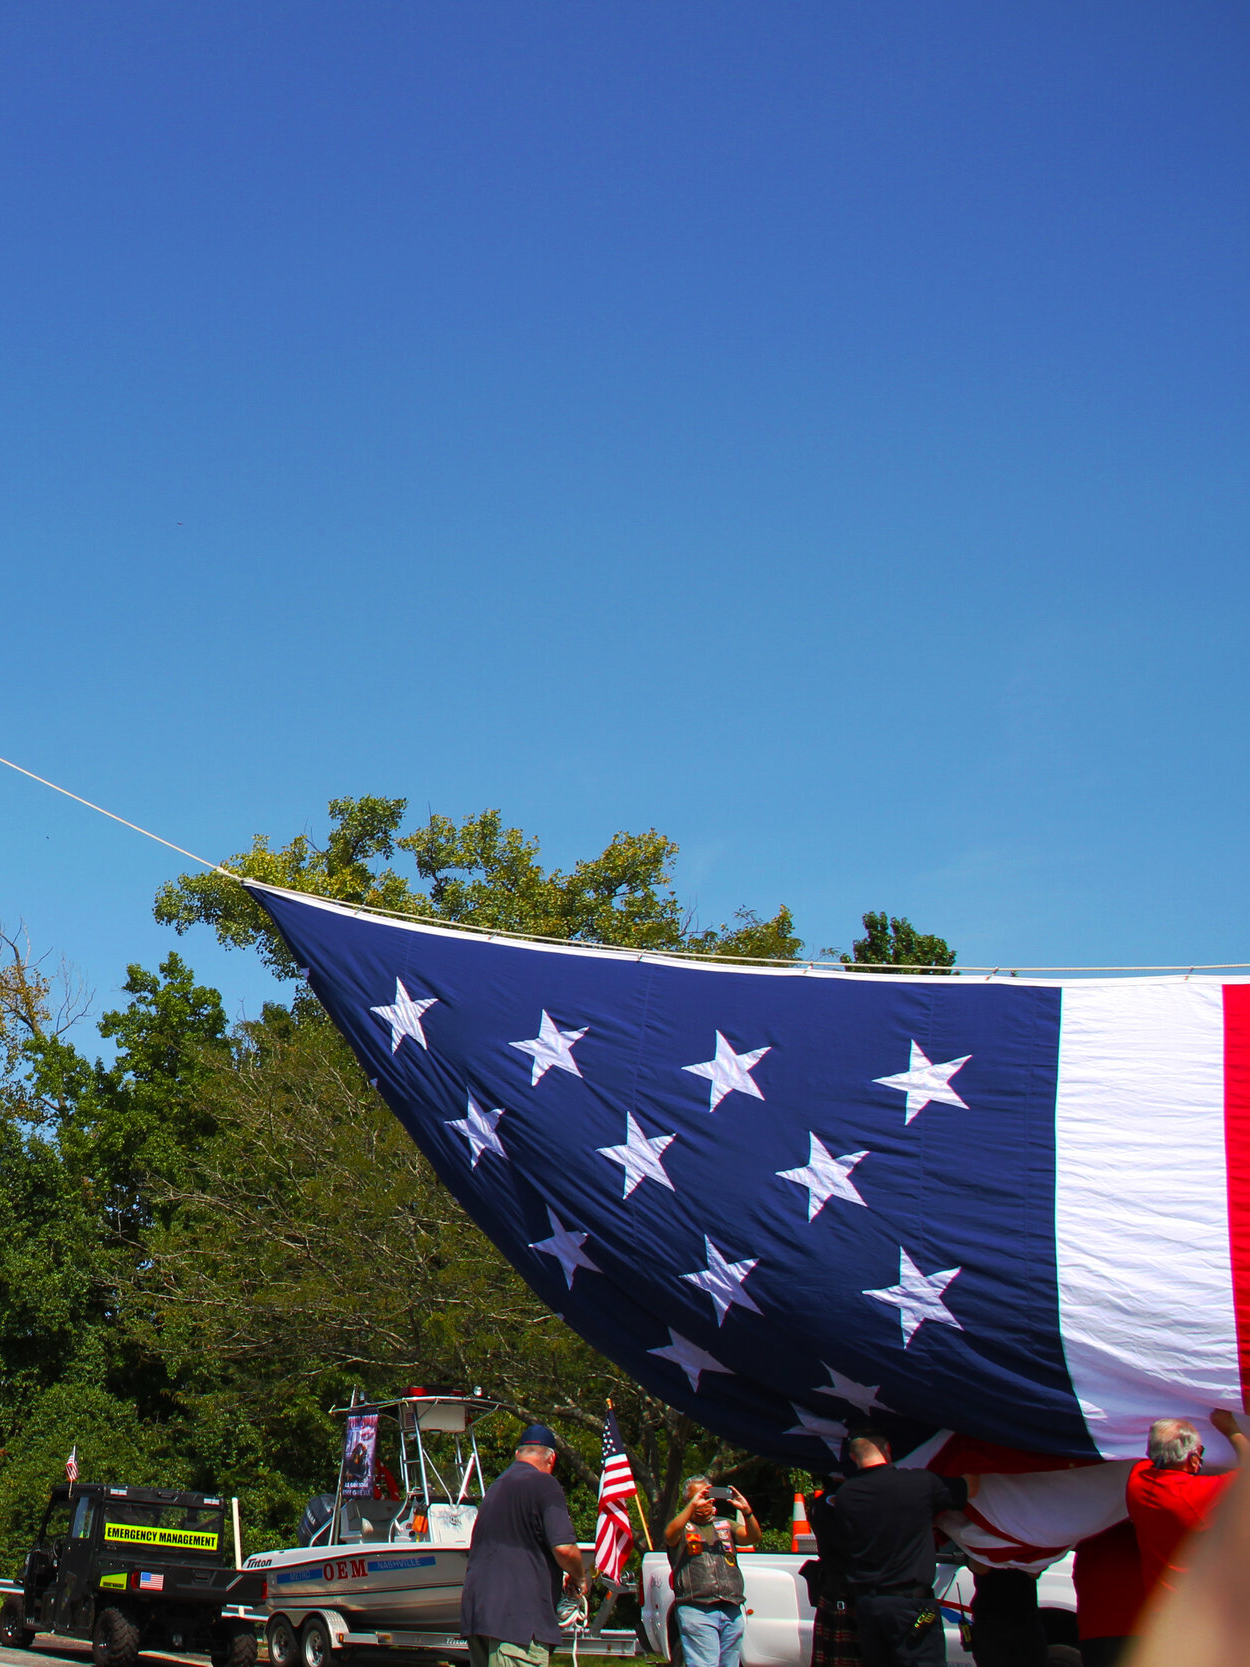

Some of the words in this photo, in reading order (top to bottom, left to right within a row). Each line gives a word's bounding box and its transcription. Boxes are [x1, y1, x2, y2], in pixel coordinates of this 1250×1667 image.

[107, 1527, 157, 1541] EMERGENCY
[159, 1532, 216, 1547] MANAGEMENT
[246, 1557, 272, 1568] Triton
[323, 1559, 368, 1582] OEM
[378, 1557, 421, 1569] NASHVILLE
